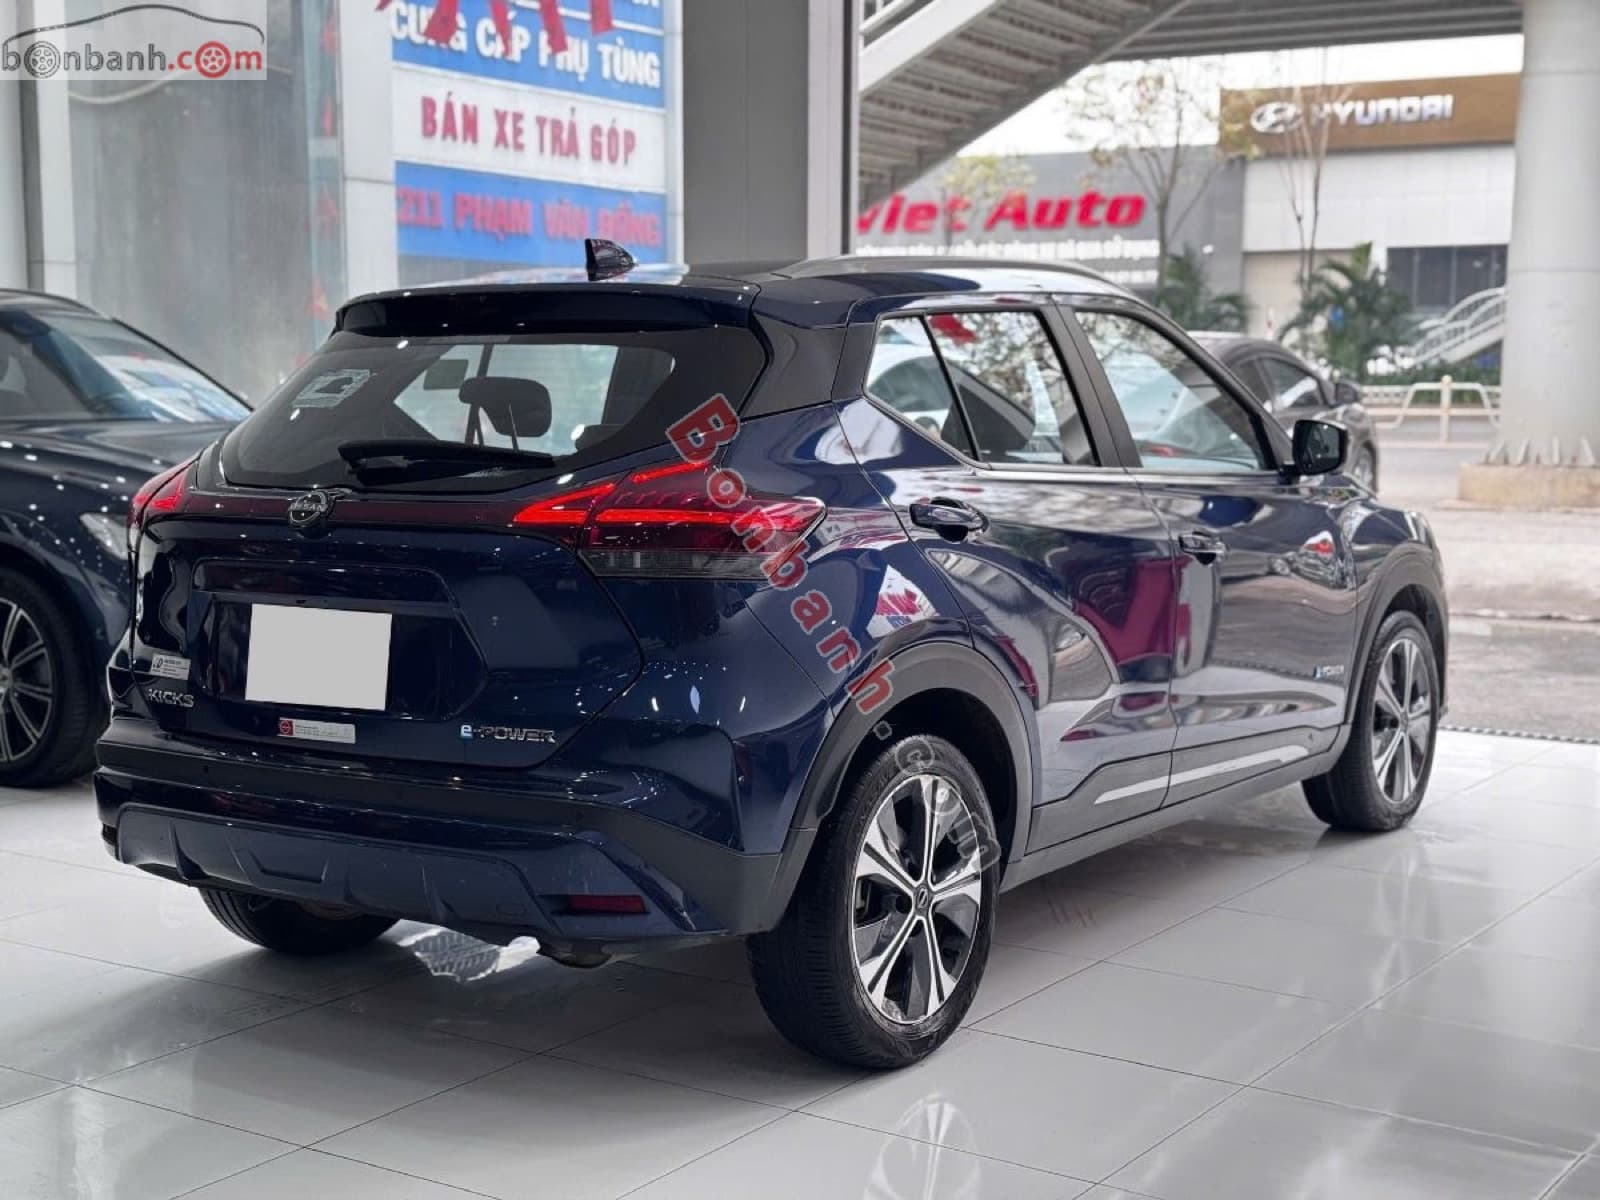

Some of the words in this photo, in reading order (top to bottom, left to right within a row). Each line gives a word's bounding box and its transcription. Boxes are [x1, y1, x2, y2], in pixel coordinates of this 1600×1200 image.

[391, 1, 467, 52] CUG
[597, 36, 661, 88] TÙNG
[421, 91, 479, 145] BÁN
[493, 108, 525, 152] XE
[535, 107, 580, 159] TRẢ
[590, 118, 637, 165] GÓP
[397, 187, 443, 228] 211
[984, 190, 1147, 231] Auto
[148, 688, 194, 708] KICKS
[460, 724, 556, 743] e-POWER
